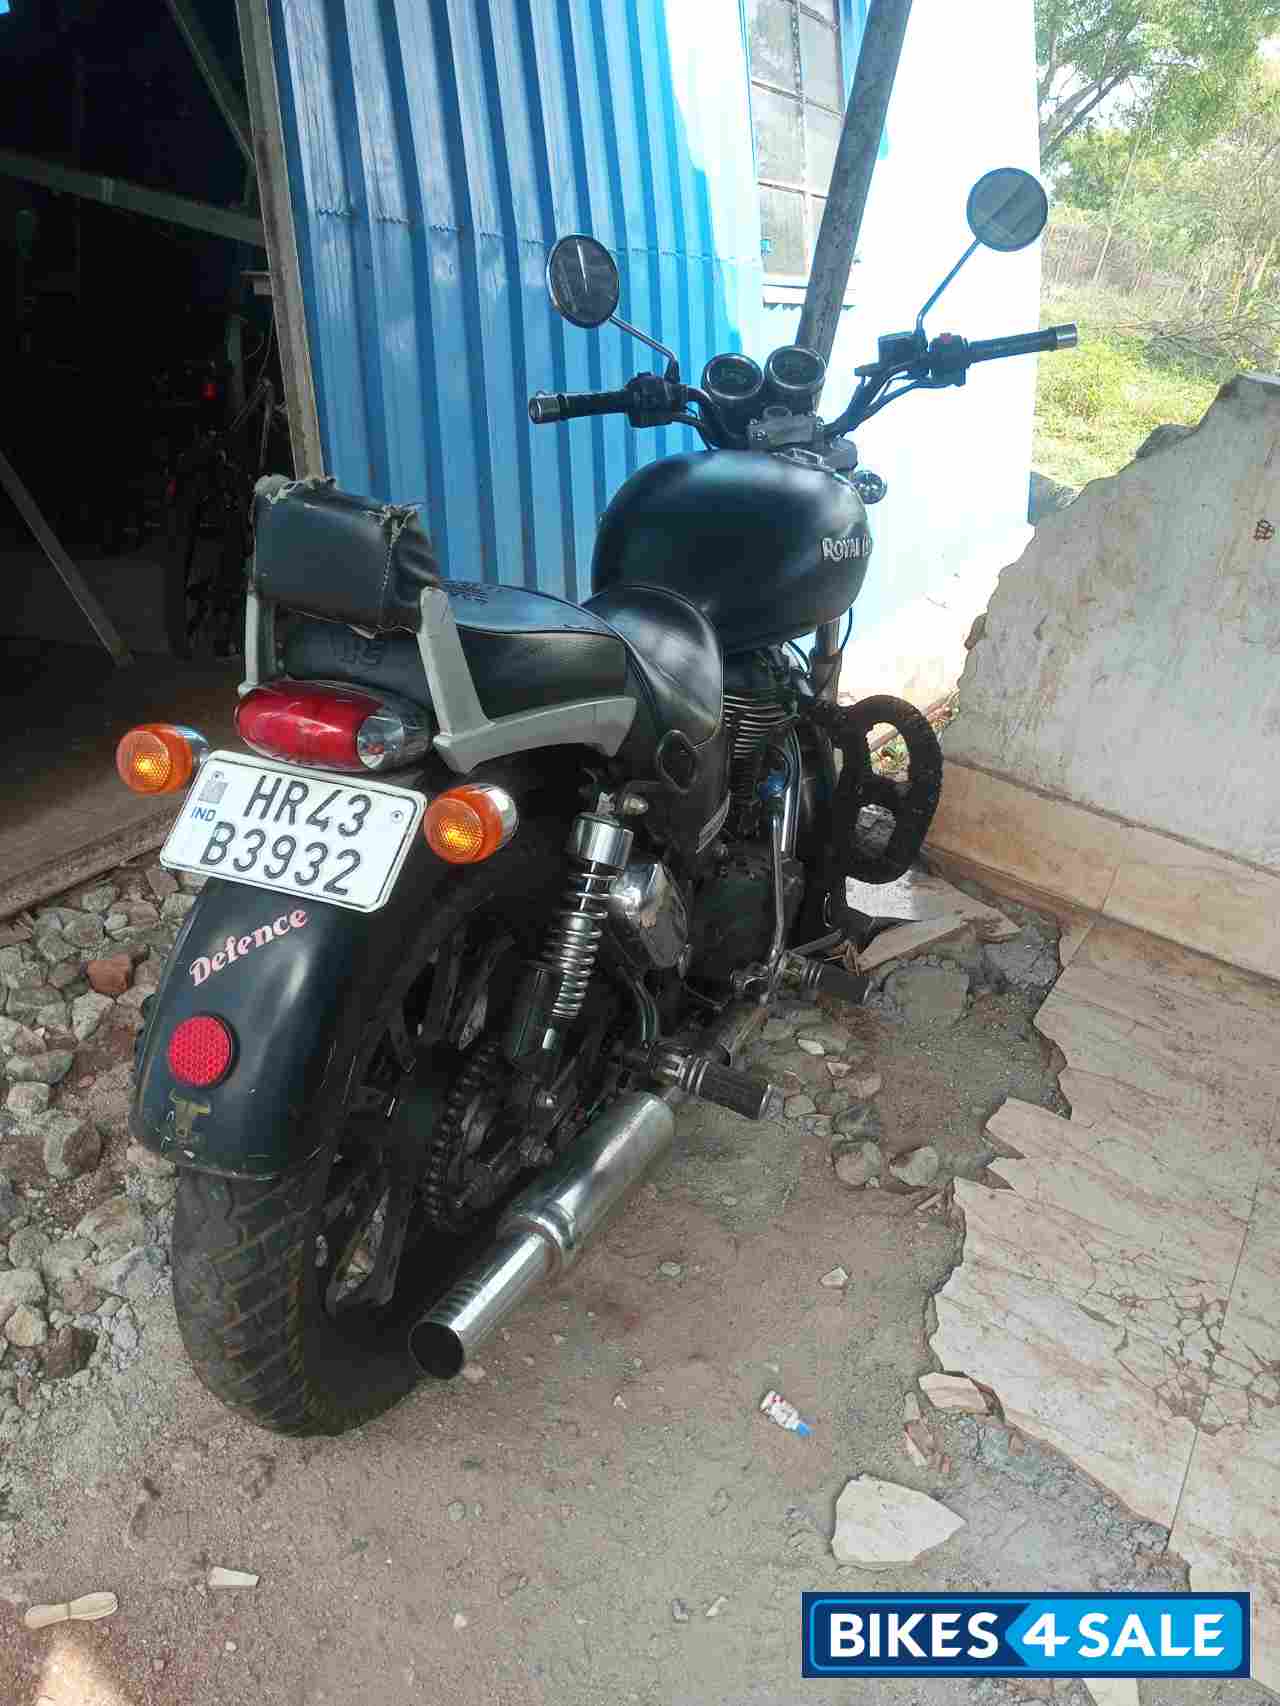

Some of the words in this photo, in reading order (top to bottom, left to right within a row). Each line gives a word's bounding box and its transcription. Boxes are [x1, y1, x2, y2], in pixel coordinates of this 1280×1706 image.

[191, 806, 216, 822] IND
[200, 821, 361, 896] B3932
[189, 909, 307, 986] Defence
